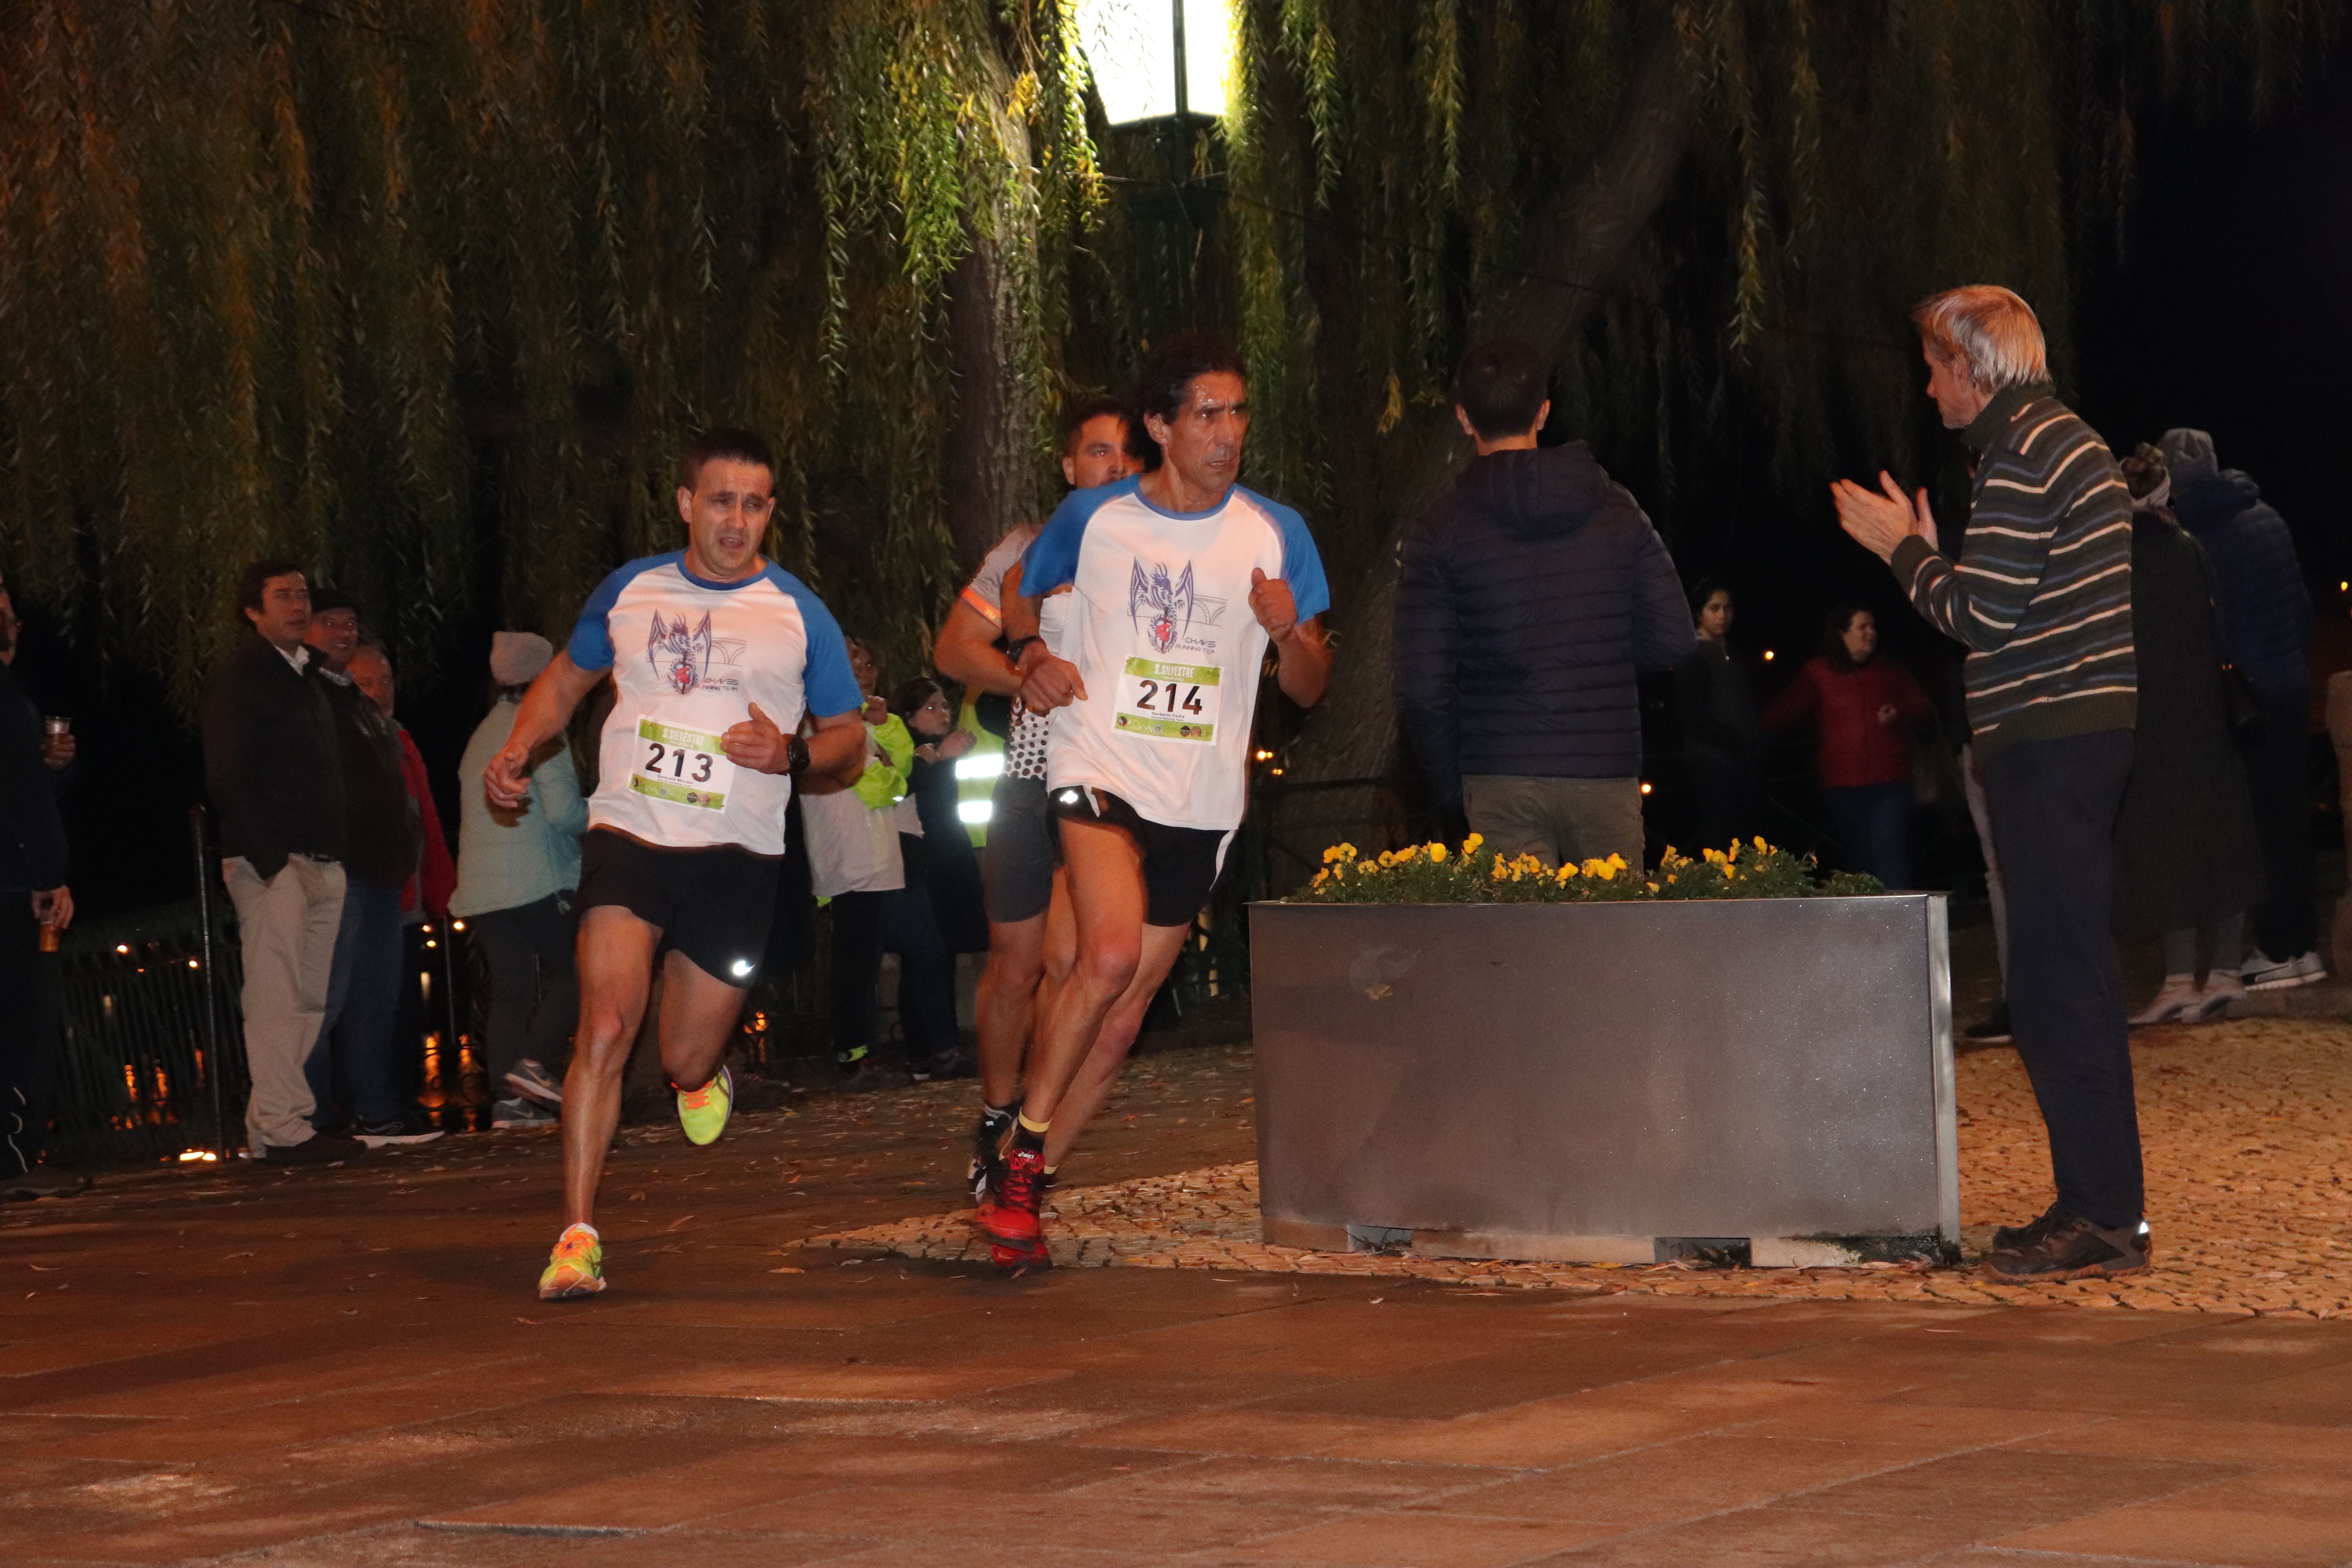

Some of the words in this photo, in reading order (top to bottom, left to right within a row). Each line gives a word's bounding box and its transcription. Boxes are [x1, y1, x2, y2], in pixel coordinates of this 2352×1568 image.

[1154, 664, 1194, 678] S.SILVESTRE
[1137, 679, 1202, 715] 214
[645, 743, 713, 782] 213
